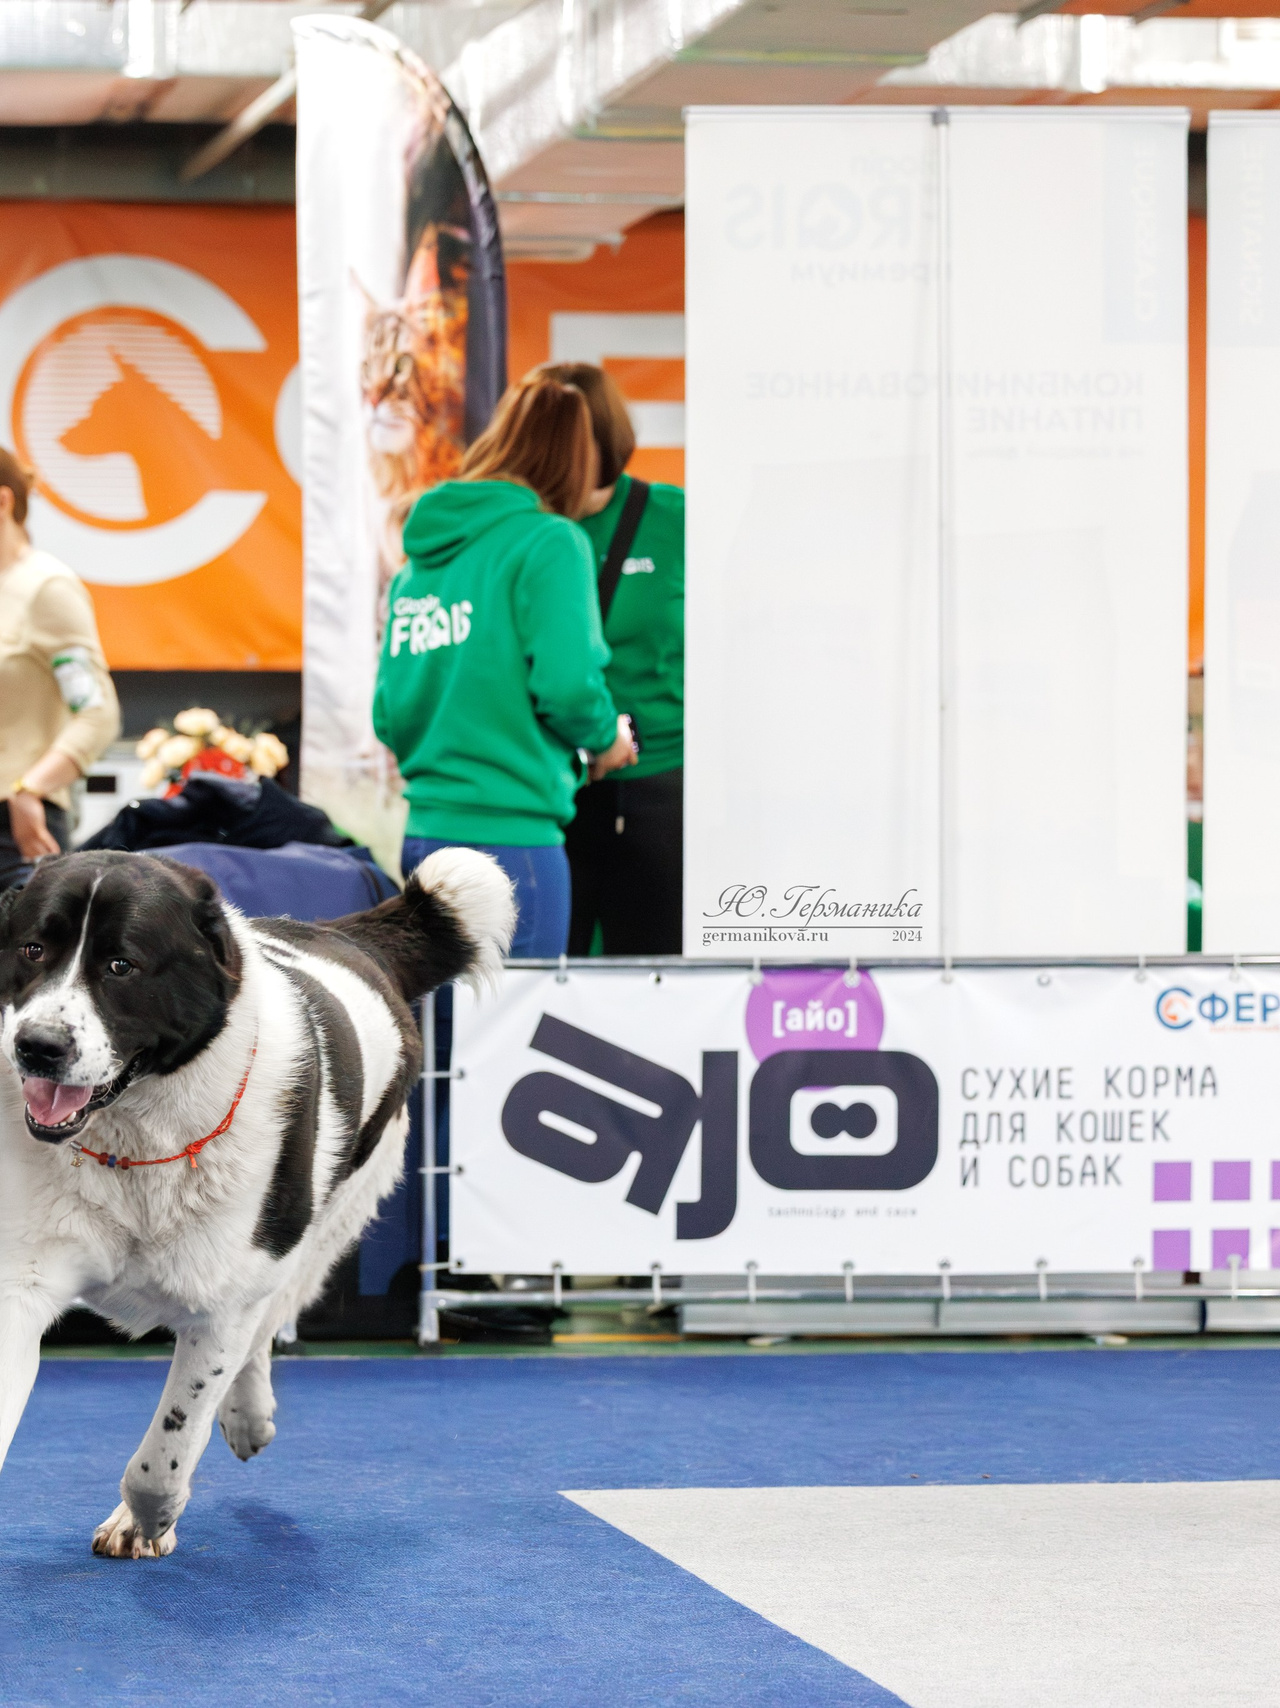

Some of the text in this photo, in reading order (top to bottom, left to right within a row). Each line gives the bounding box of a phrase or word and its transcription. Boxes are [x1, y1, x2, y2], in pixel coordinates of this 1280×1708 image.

[961, 1065, 1218, 1100] СУХИЕ КОРМА
[959, 1110, 1171, 1150] ДЛЯ КОШЕК
[961, 1154, 1123, 1188] И СОБАК
